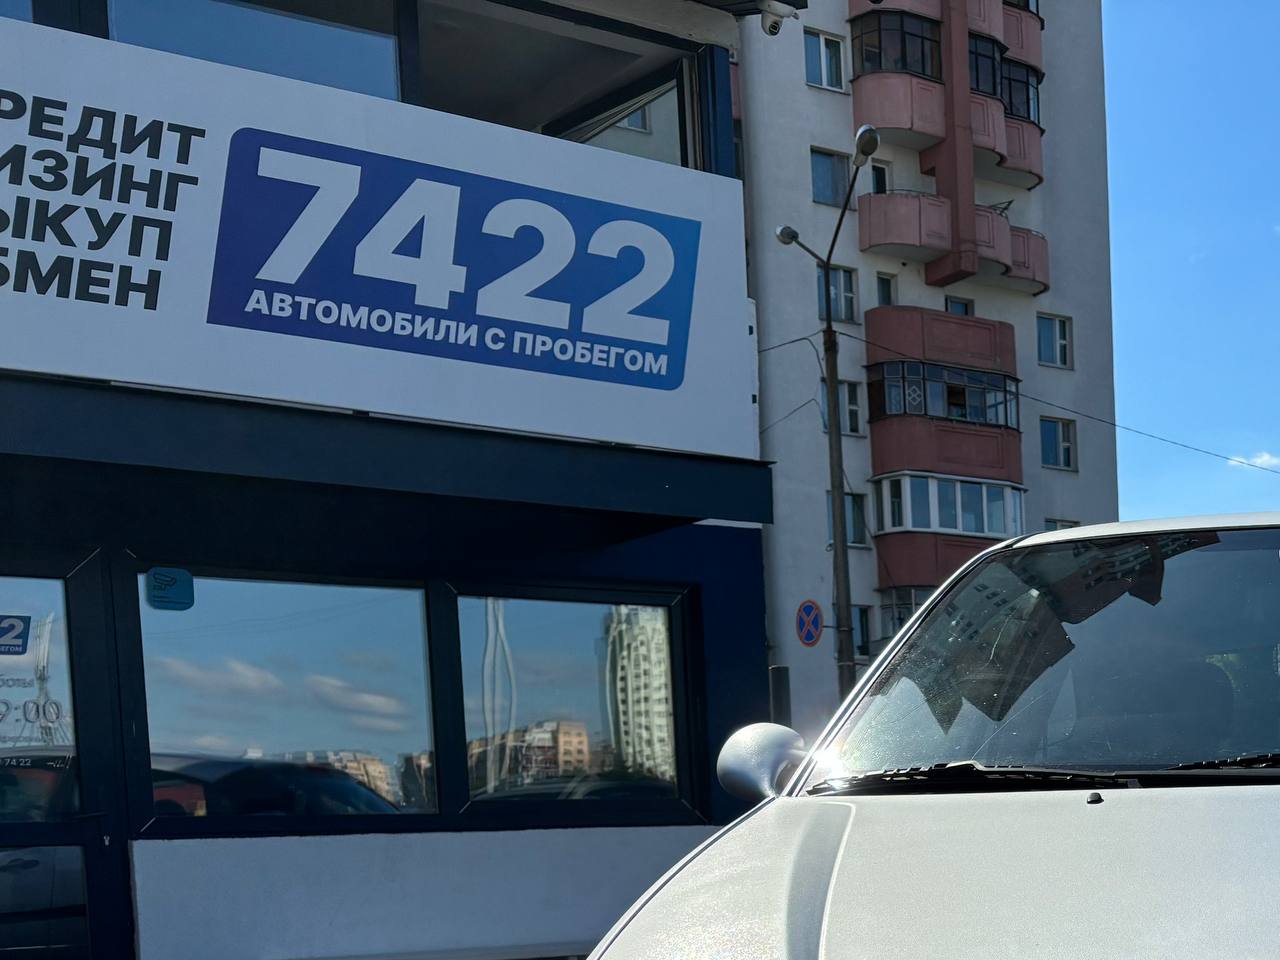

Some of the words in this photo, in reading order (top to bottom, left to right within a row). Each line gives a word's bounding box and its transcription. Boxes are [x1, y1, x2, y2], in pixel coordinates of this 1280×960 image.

[0, 246, 162, 311] МЕН
[254, 146, 676, 346] 7422
[244, 289, 479, 347] АВТОМОБИЛИ
[484, 328, 506, 351] С
[512, 331, 668, 376] ПРОБЕГОМ
